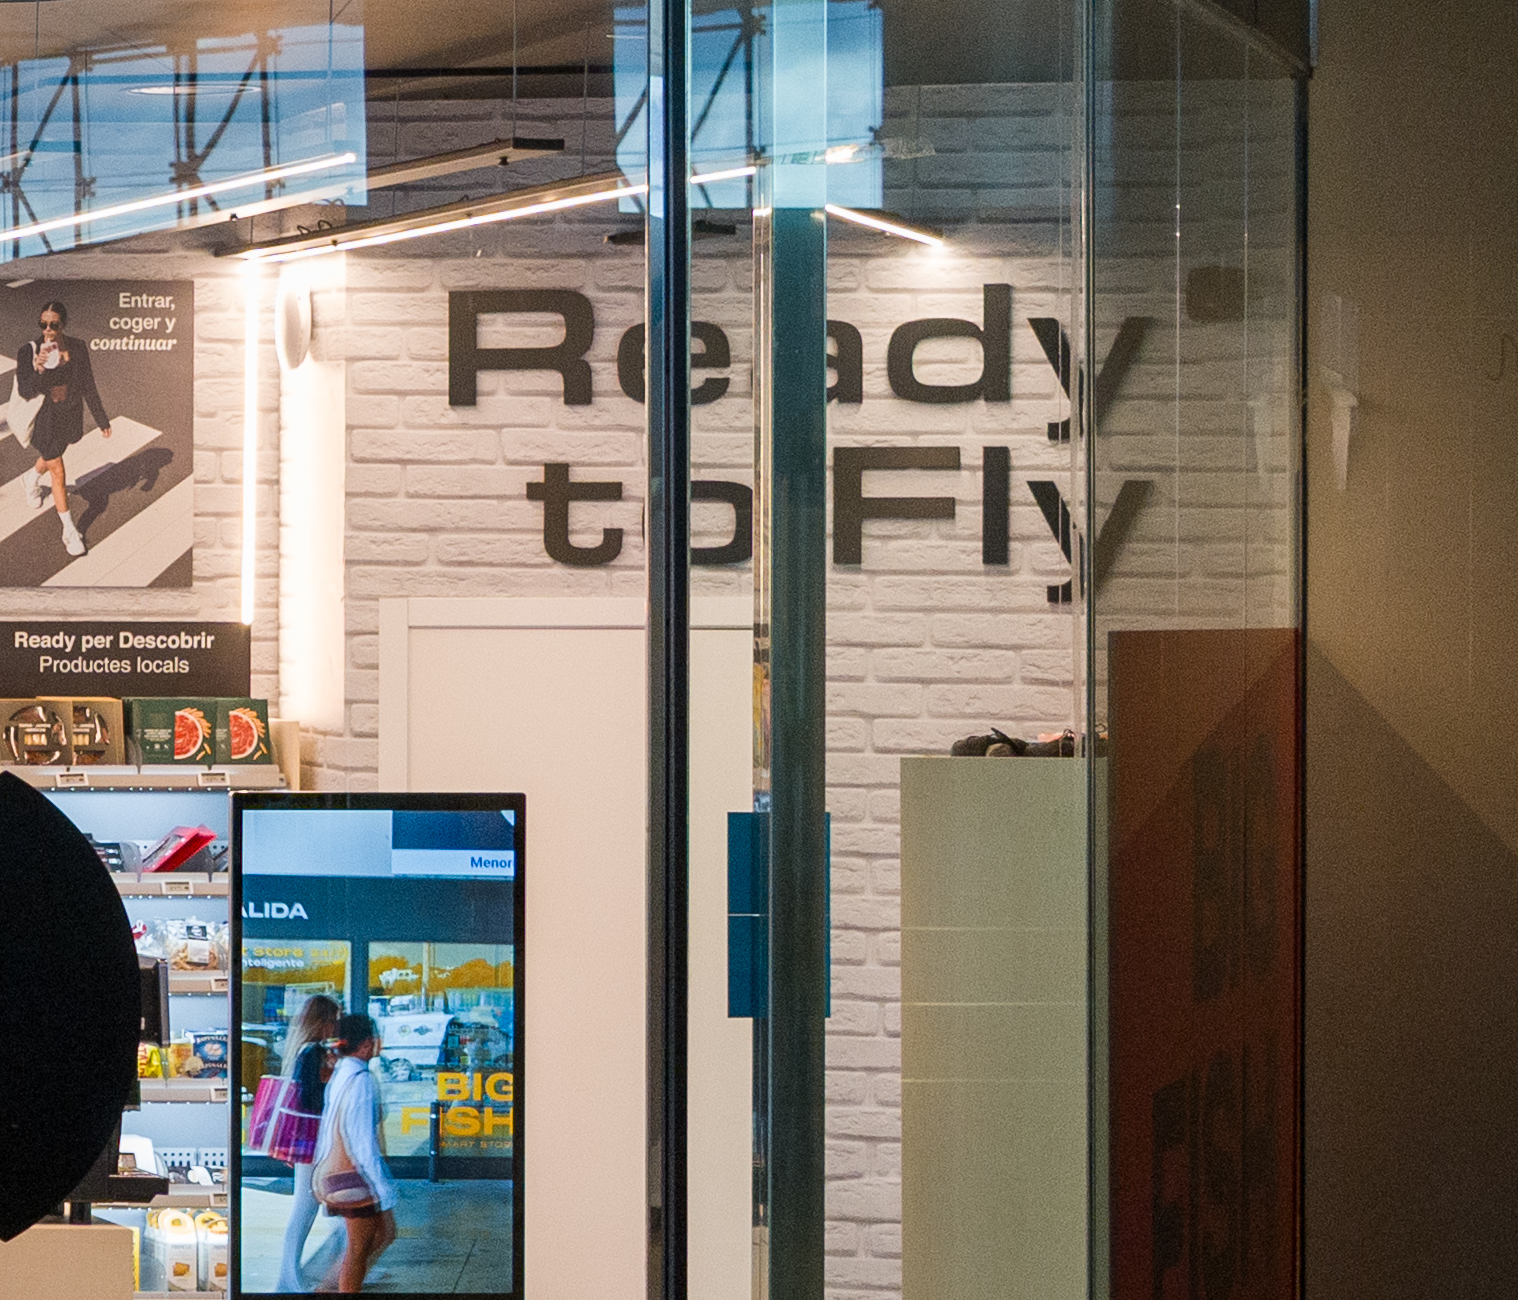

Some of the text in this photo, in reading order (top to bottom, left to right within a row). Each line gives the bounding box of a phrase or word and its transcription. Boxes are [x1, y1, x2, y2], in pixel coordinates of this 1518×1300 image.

[118, 292, 176, 311] Entrar,
[109, 316, 177, 334] coger y
[90, 335, 178, 352] continuar
[526, 446, 1154, 604] to Fly
[14, 631, 215, 652] Ready per Descobrir
[38, 656, 190, 673] Productes locals
[437, 1072, 514, 1102] BIG
[401, 1106, 514, 1137] FSH
